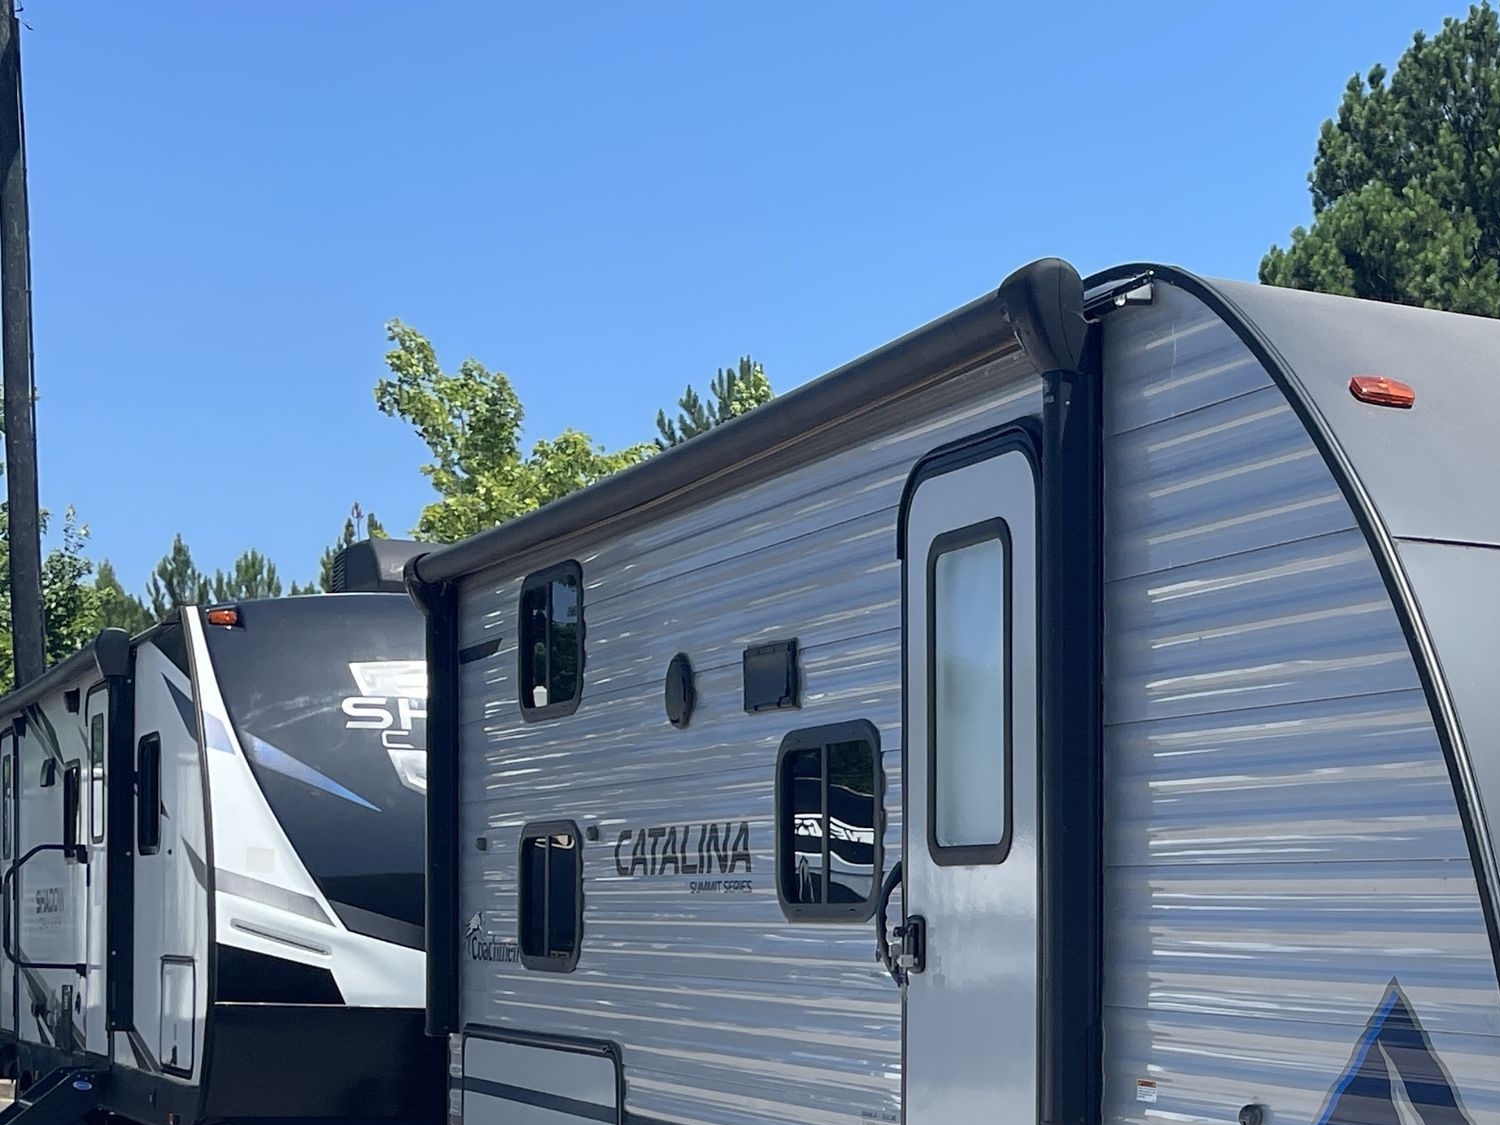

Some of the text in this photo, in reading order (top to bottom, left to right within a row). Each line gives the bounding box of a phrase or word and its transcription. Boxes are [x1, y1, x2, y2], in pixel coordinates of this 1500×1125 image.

[614, 821, 752, 876] CATALINA
[689, 879, 753, 894] SUMMIT SERIES
